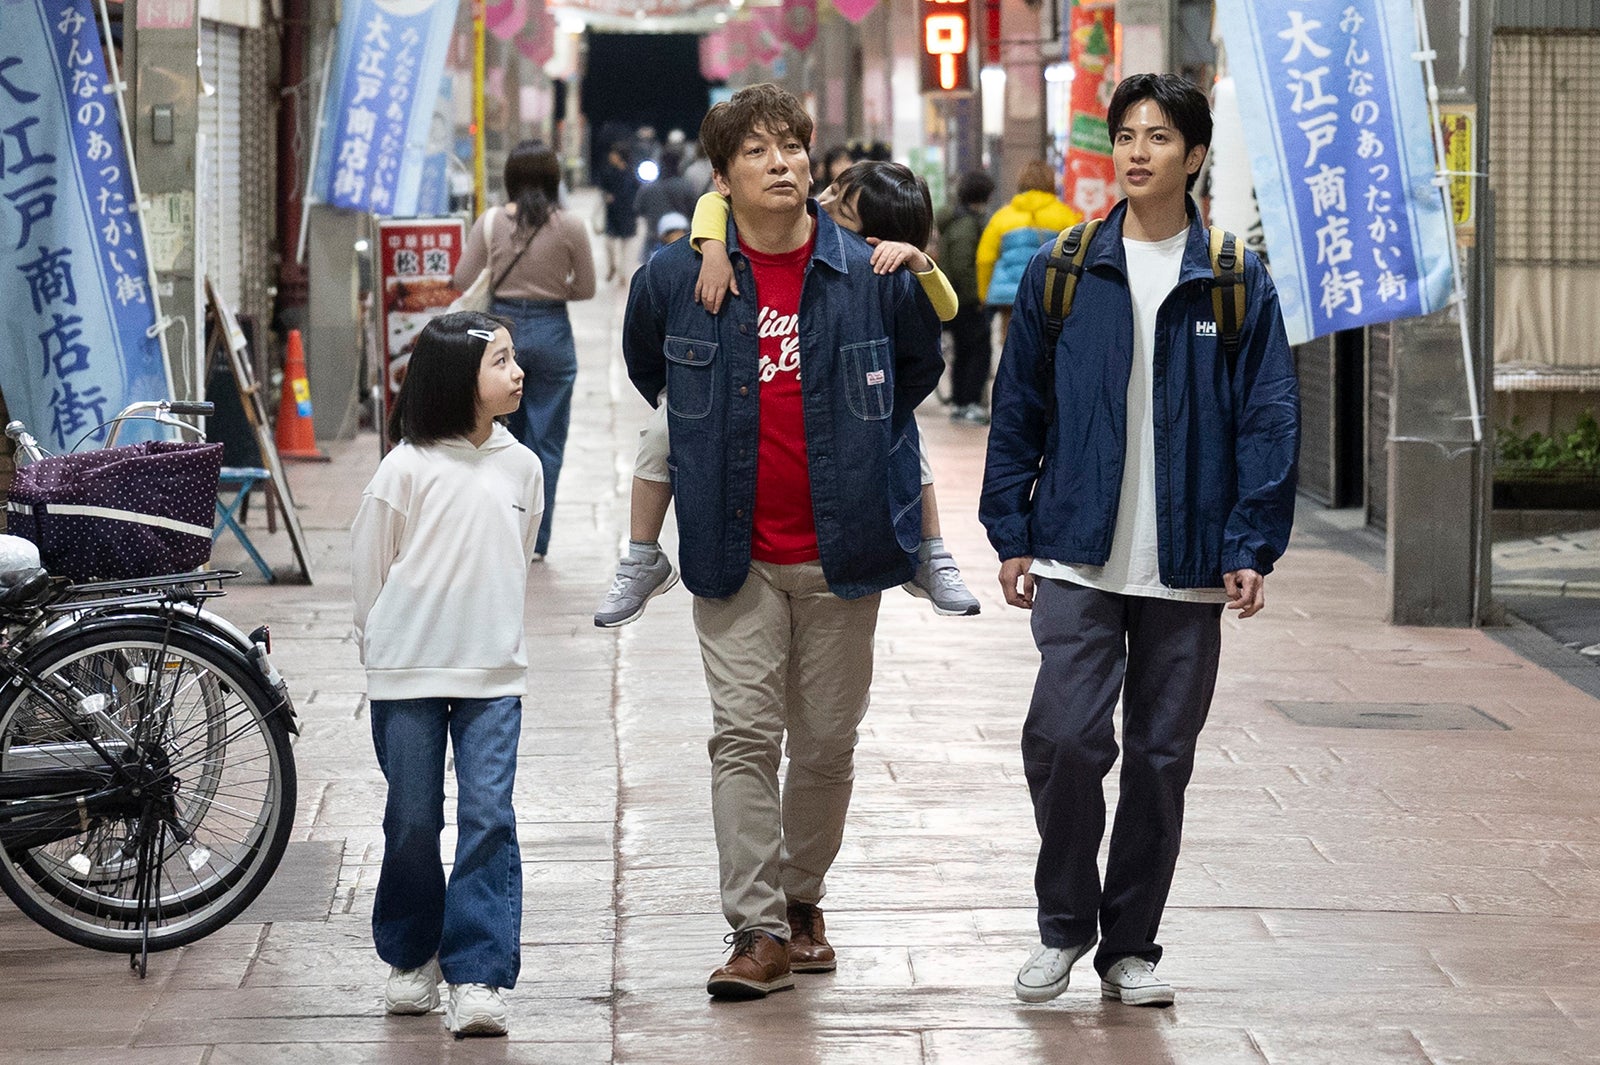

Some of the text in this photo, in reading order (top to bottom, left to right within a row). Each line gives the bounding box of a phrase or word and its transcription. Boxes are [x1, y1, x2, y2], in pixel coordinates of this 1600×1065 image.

[57, 7, 146, 307] みんなのあったかい街
[334, 13, 391, 204] 大江戸商店街
[1277, 10, 1364, 319] 大江戸商店街
[1339, 5, 1408, 304] みんなのあったかい街
[1195, 321, 1217, 334] HH
